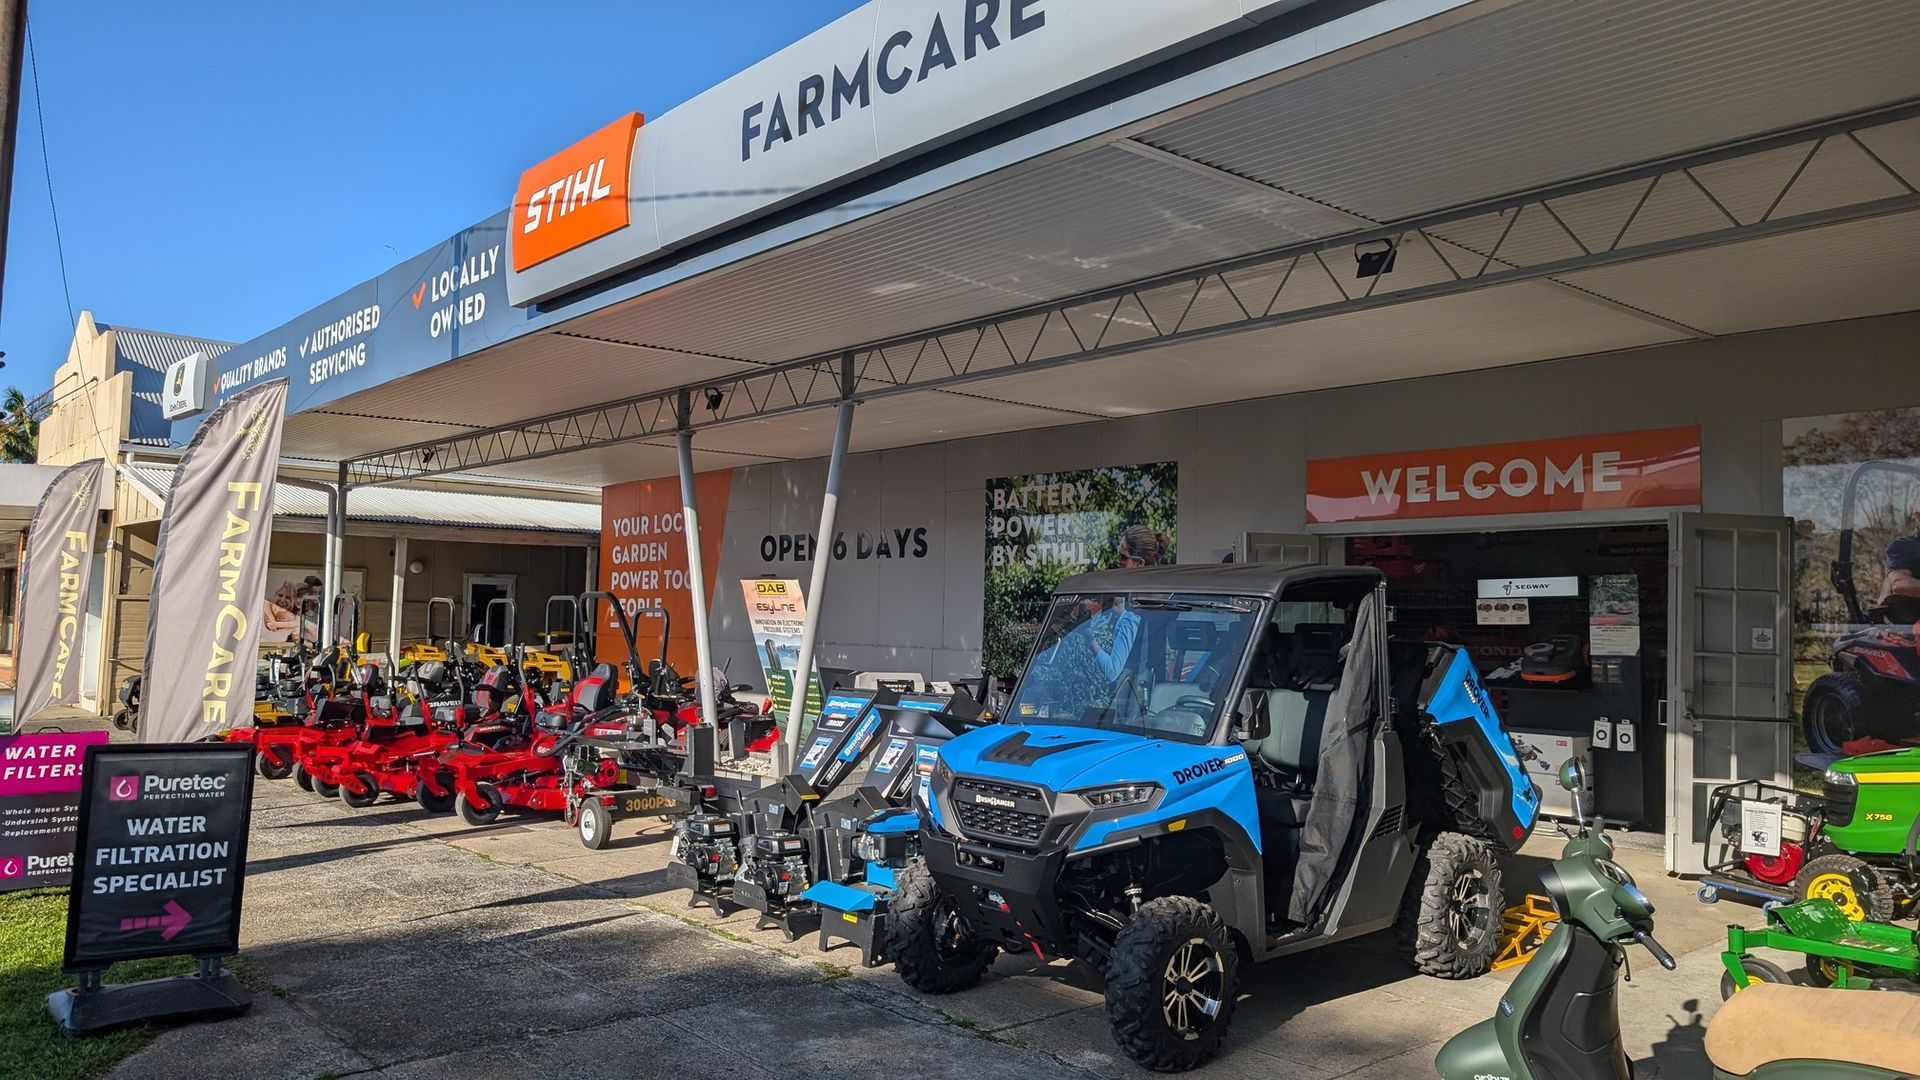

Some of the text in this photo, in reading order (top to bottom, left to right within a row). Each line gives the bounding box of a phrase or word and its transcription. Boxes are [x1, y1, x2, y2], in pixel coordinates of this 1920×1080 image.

[741, 0, 1046, 162] FARMCARE
[523, 157, 611, 234] STIHL
[431, 245, 500, 303] LOCALLY
[430, 292, 486, 339] OWNED
[310, 305, 380, 355] AUTHORISED
[221, 346, 287, 394] QUALITY BRANDS
[309, 342, 366, 385] SERVICING
[1360, 450, 1622, 505] WELCOME
[993, 480, 1092, 510] BATTERY
[612, 512, 686, 538] YOUR LOC
[612, 541, 668, 564] GARDEN
[832, 531, 848, 561] 6
[856, 527, 929, 560] DAYS
[992, 542, 1099, 567] BY STIHL.
[611, 570, 659, 590] POWER
[757, 583, 786, 593] DAB
[50, 528, 88, 700] FARMCARE
[202, 481, 263, 724] FARMCARE
[4, 744, 77, 760] WATER
[144, 773, 227, 792] Puretec
[1172, 753, 1245, 785] DROVER 1000
[144, 791, 226, 800] PERFECTING WATER
[34, 806, 61, 814] House
[127, 815, 207, 836] WATER
[95, 841, 229, 866] FILTRATION
[27, 867, 72, 877] PERFECTING
[92, 868, 228, 895] SPECIALIST
